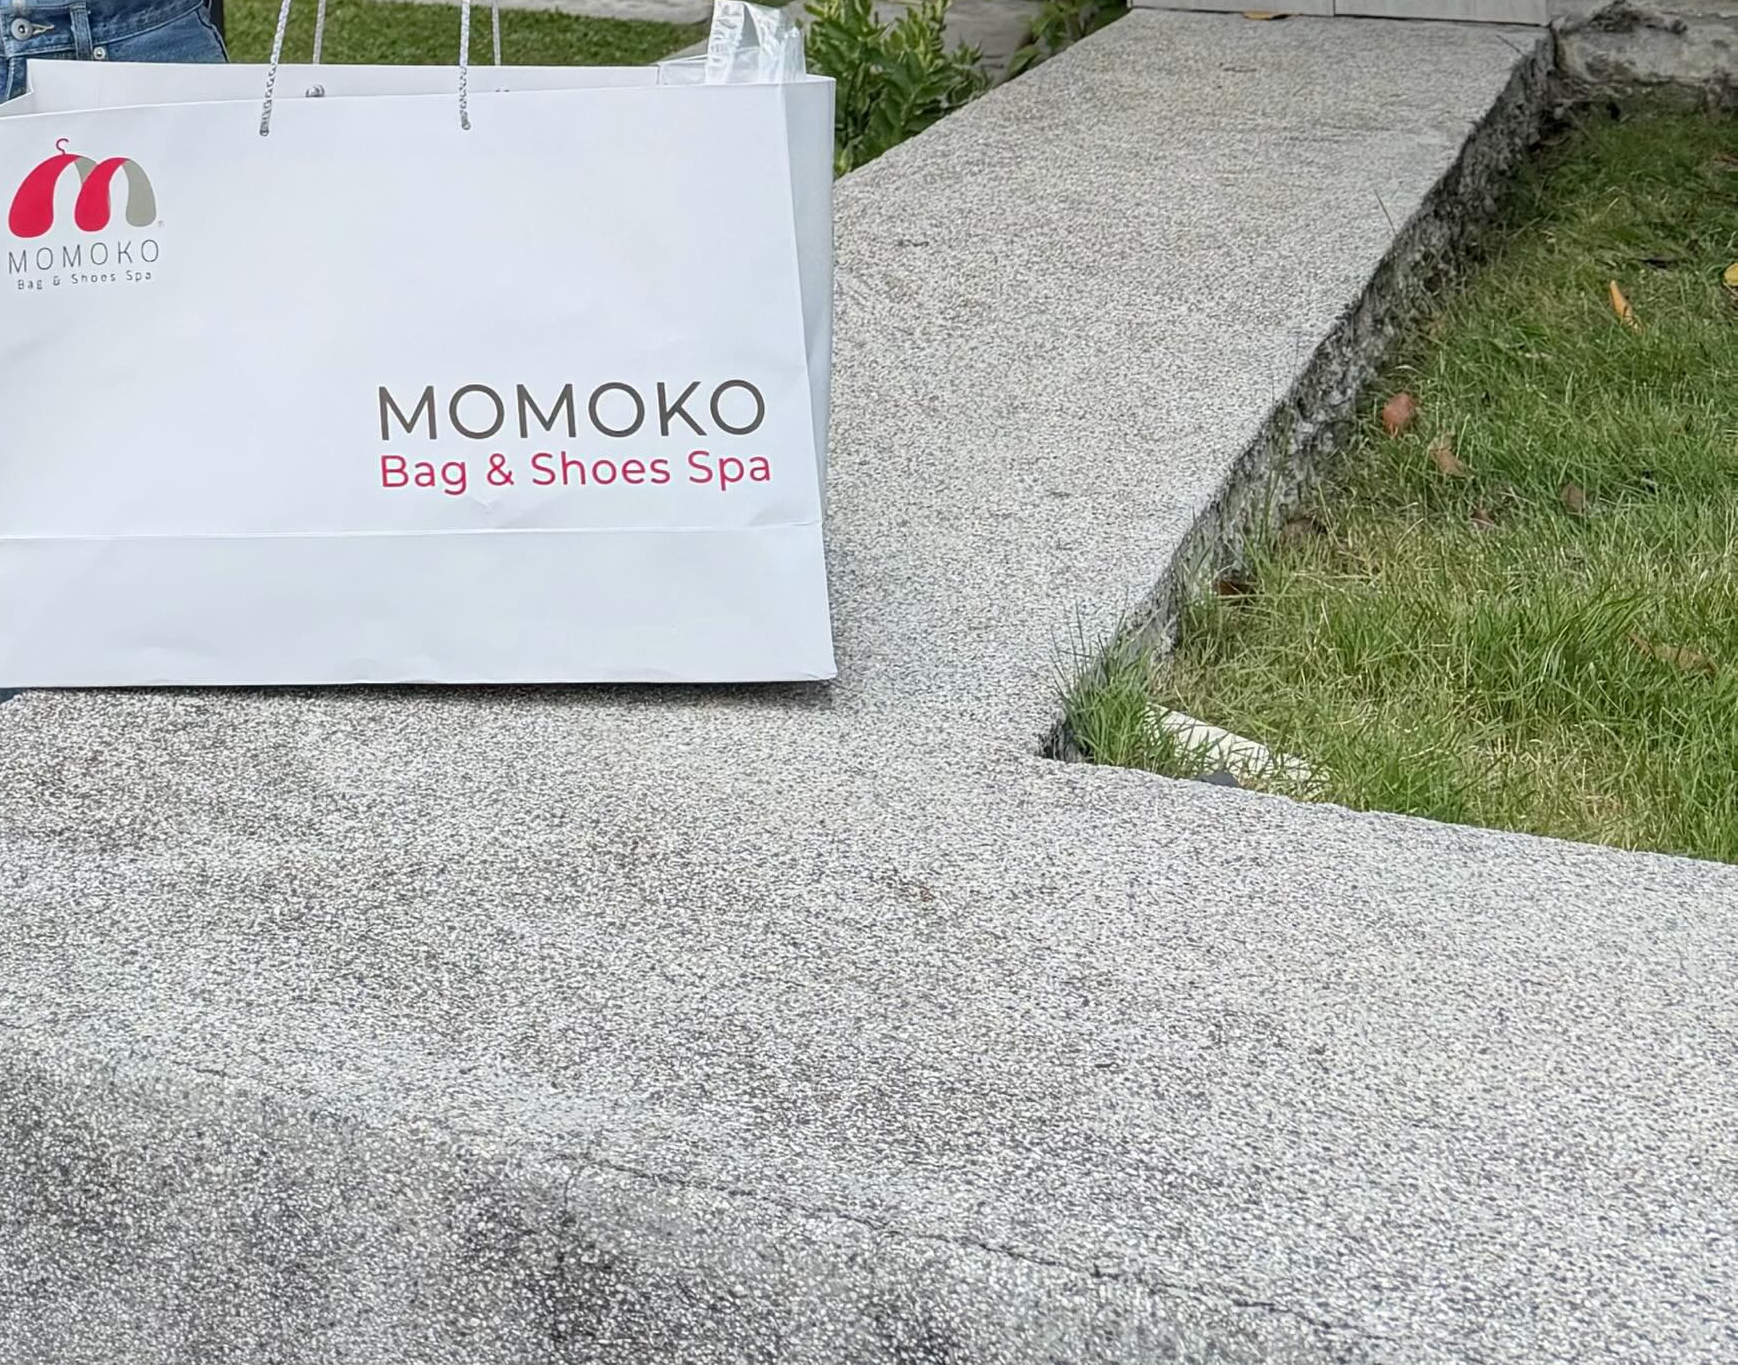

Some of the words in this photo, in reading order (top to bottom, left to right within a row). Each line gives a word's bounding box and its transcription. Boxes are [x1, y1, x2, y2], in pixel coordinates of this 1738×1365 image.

[8, 238, 159, 274] MOMOKO
[17, 278, 44, 291] Bag
[52, 274, 61, 287] &
[70, 273, 117, 285] Shoes
[125, 269, 152, 283] Spa
[378, 379, 765, 441] MOMOKO
[380, 454, 467, 496] Bag
[486, 452, 515, 487] &
[530, 450, 671, 486] Shoes
[687, 450, 771, 492] Spa
